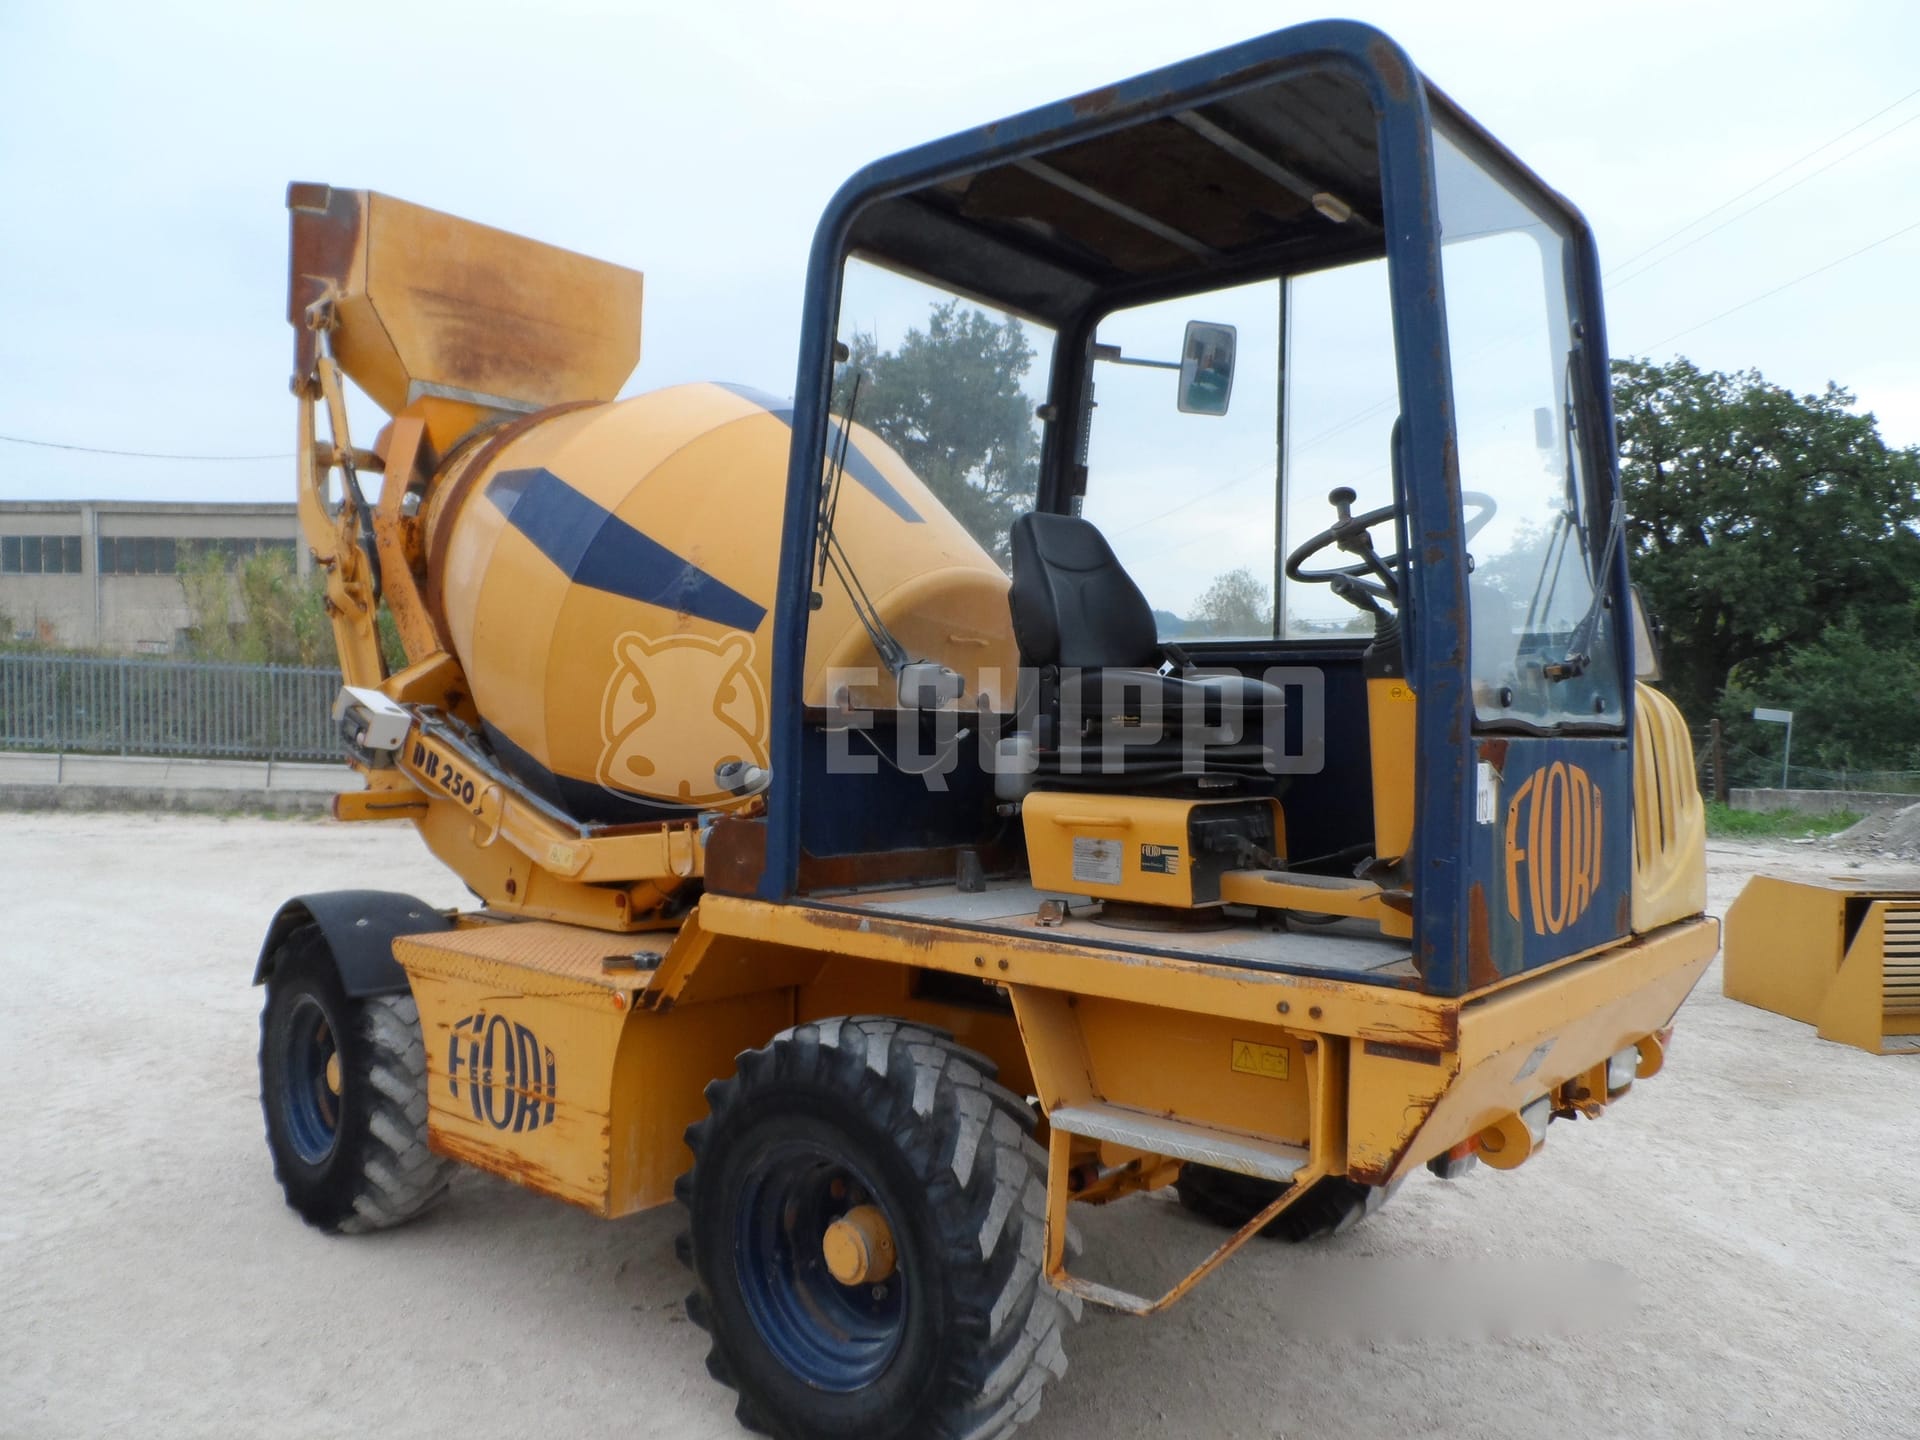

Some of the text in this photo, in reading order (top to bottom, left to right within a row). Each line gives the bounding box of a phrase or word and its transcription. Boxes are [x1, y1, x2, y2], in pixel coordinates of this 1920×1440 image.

[440, 764, 474, 805] 250
[1505, 761, 1603, 935] FIORI
[448, 1013, 556, 1133] FIORI
